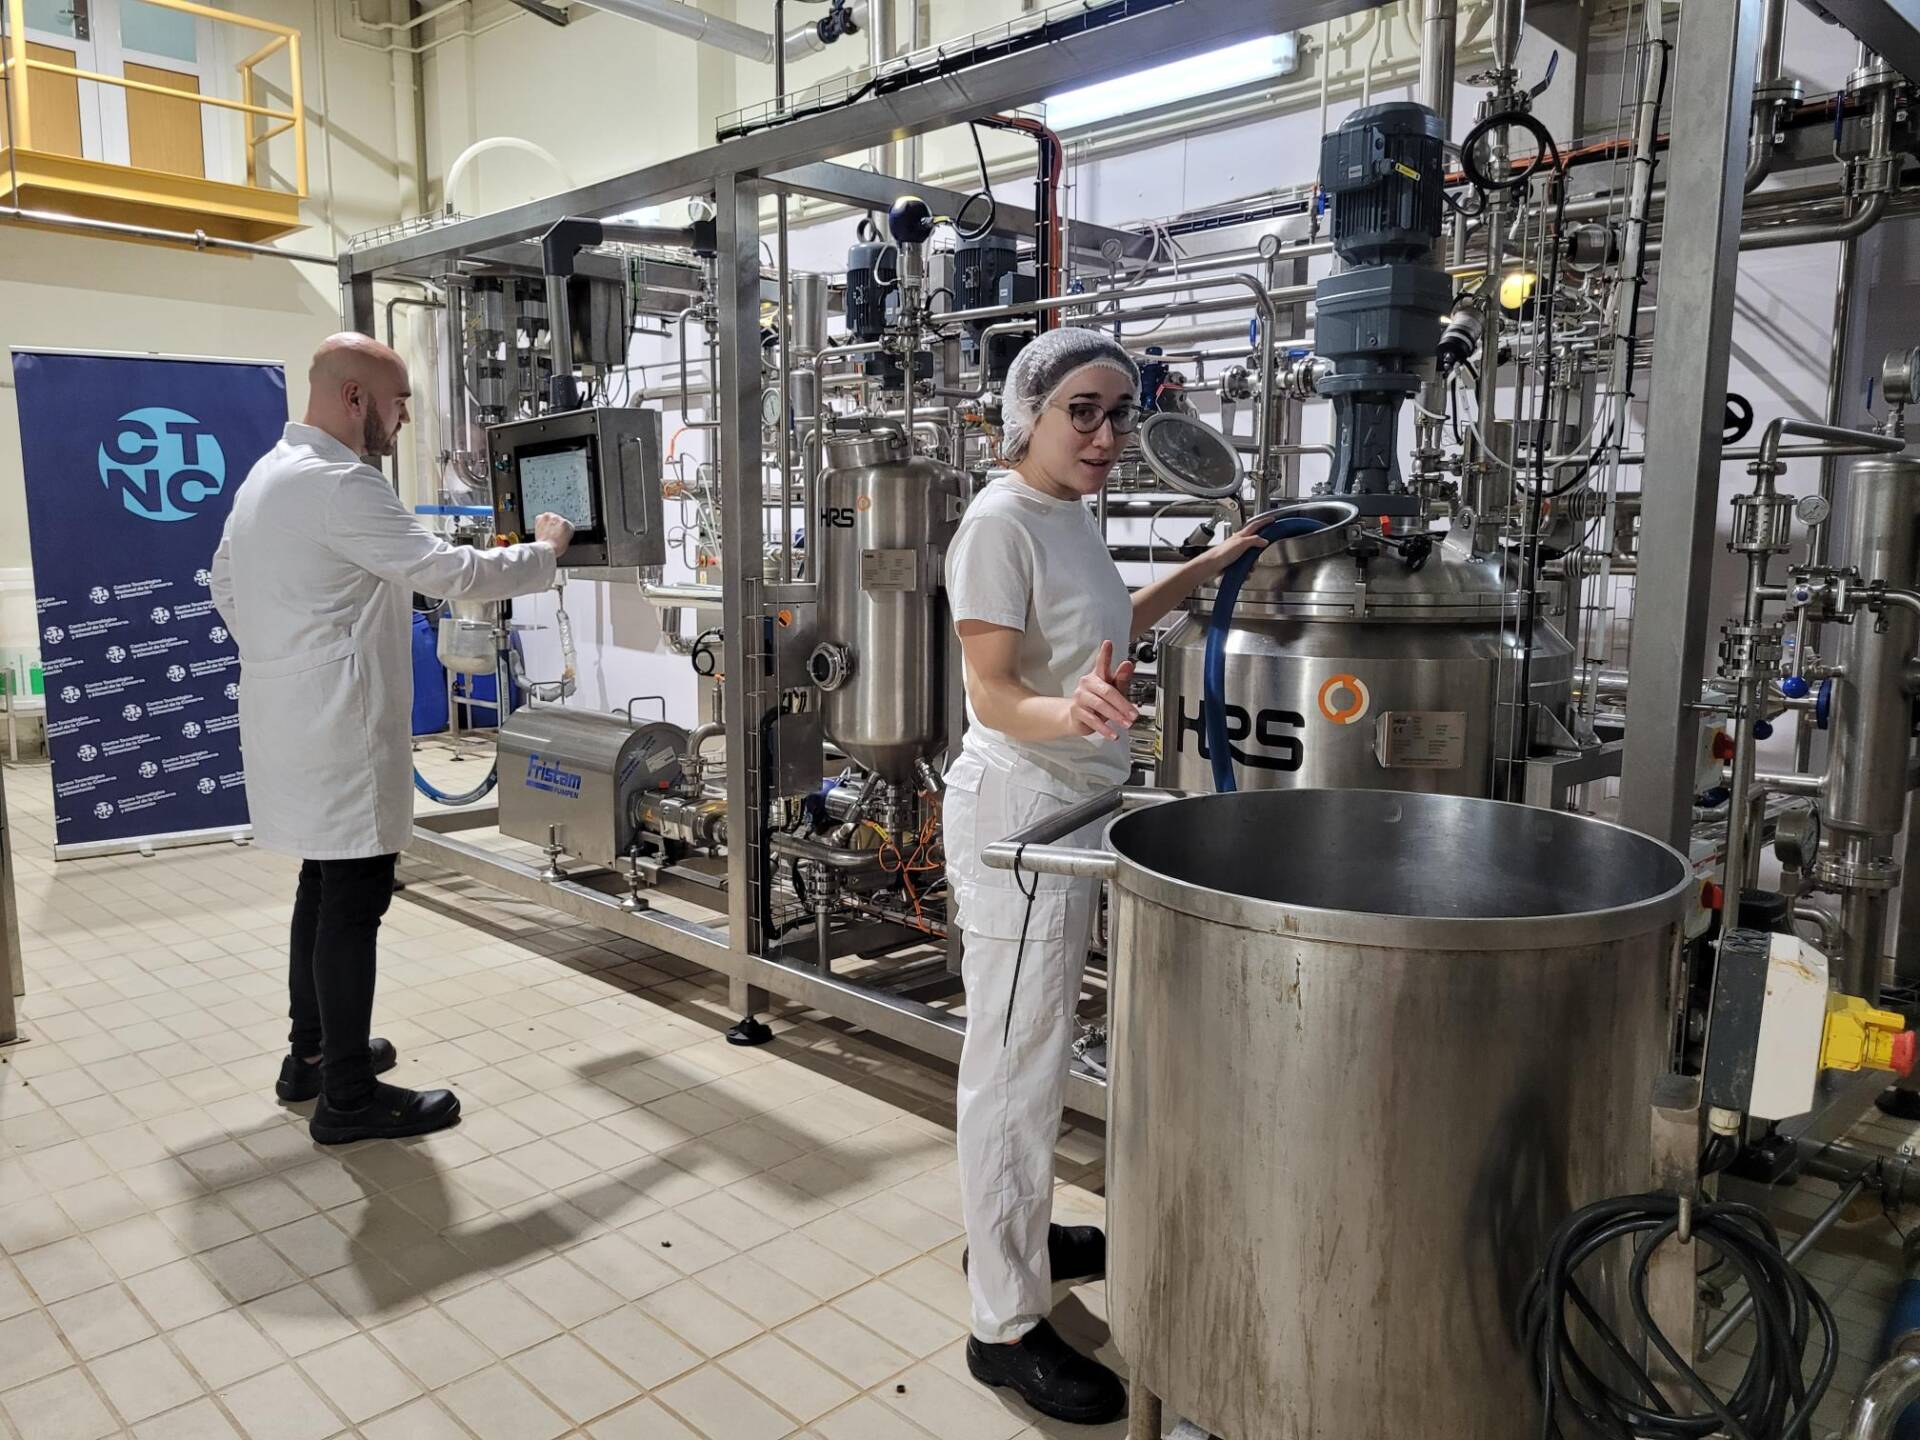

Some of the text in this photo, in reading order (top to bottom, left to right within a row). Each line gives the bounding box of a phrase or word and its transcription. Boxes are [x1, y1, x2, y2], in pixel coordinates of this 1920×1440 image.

[820, 507, 854, 528] HRS
[1177, 695, 1305, 772] HRS
[527, 752, 582, 790] Fristam
